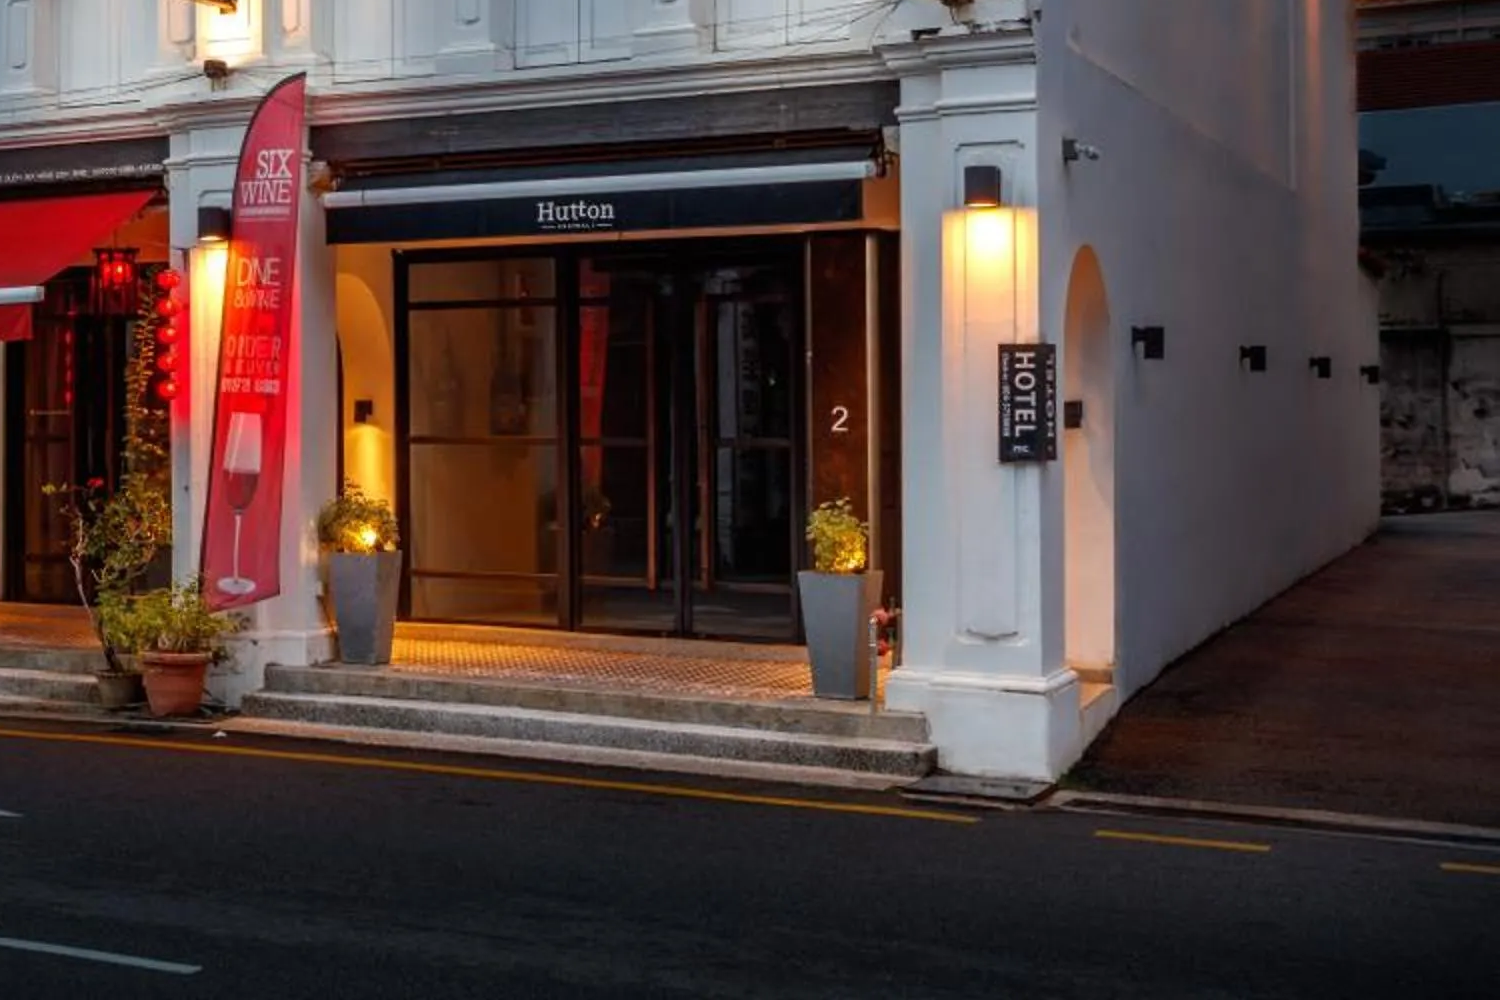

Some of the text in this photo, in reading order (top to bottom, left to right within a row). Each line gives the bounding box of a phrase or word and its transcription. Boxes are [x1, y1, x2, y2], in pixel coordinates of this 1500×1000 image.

[257, 149, 294, 179] SIX
[240, 179, 293, 206] WINE
[536, 200, 616, 223] Hutton
[1014, 352, 1037, 438] HOTEL
[831, 406, 848, 432] 2
